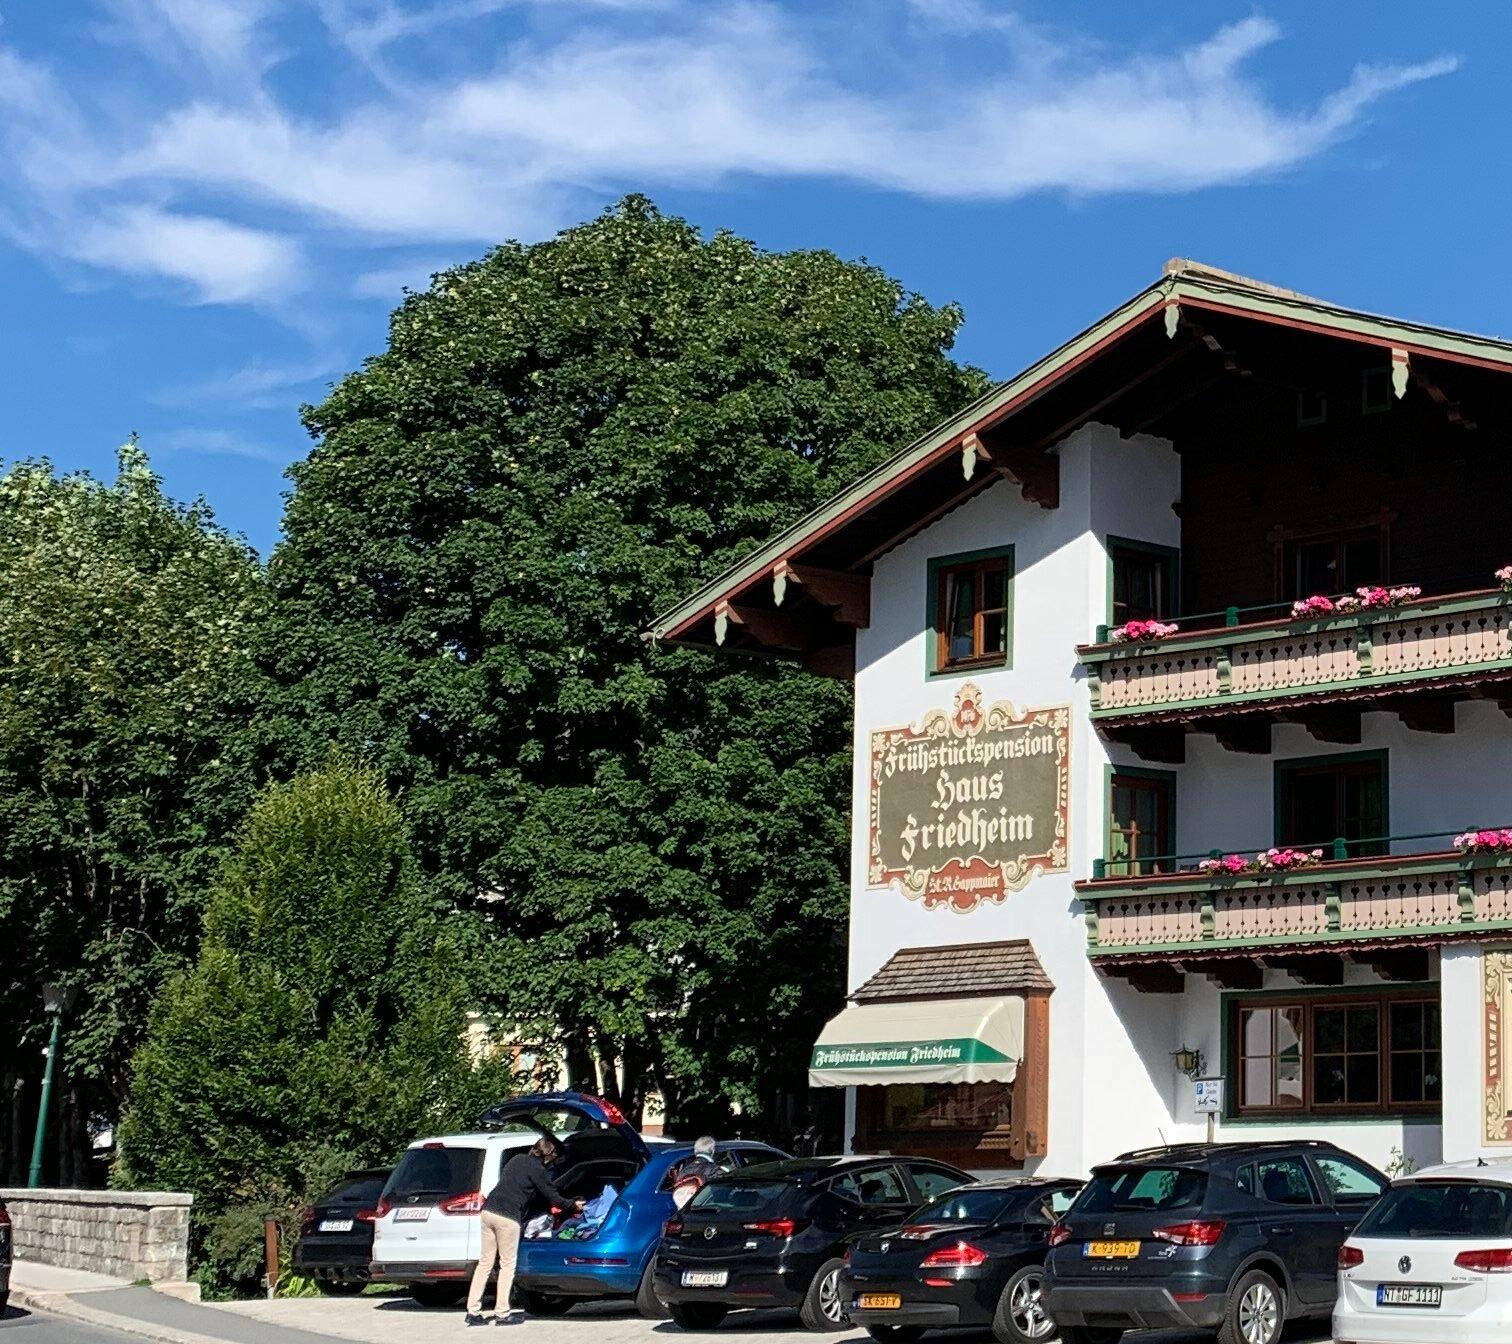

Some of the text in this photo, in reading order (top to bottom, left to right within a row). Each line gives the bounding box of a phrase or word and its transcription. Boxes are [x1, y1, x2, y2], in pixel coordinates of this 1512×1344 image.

[885, 730, 1054, 778] Frühstückspension
[931, 769, 1004, 811] Haus
[900, 807, 1034, 861] Friedheim
[815, 1045, 961, 1067] Frühstückspension Friedheim
[1384, 1286, 1440, 1303] NT GF 1111
